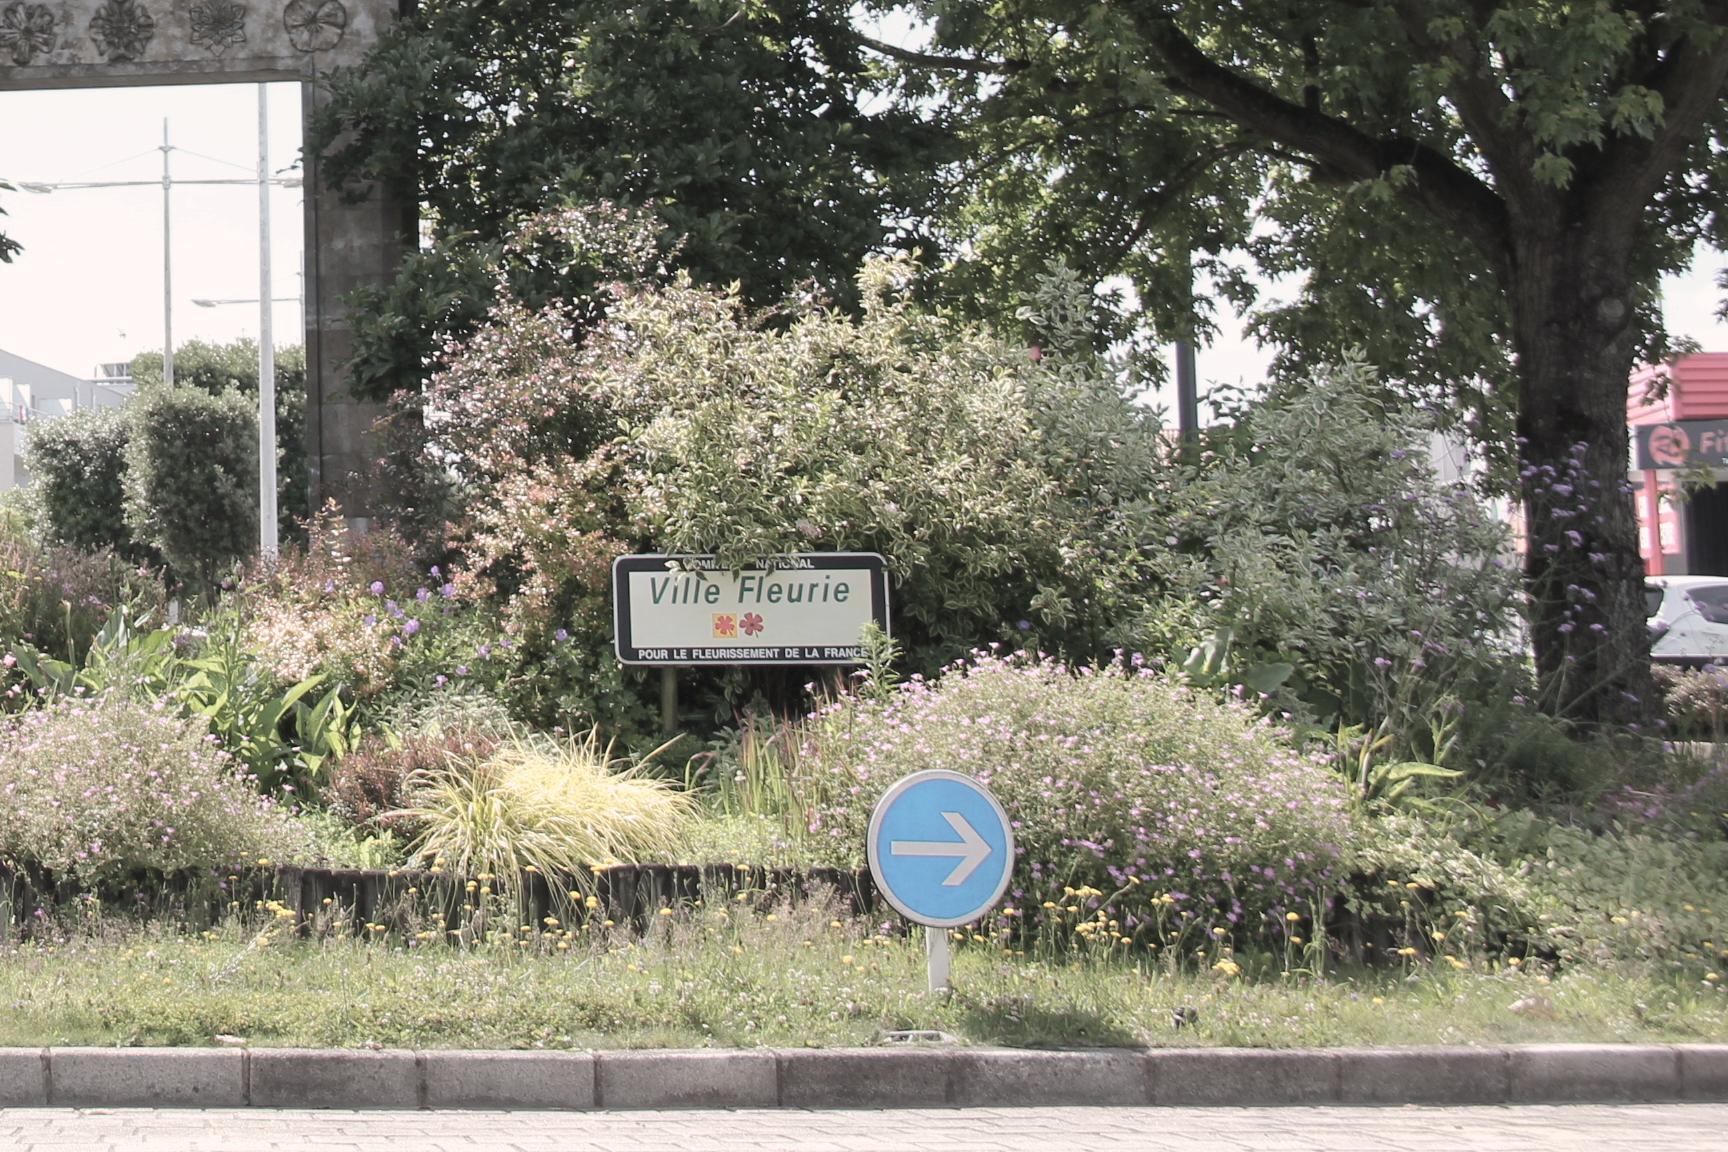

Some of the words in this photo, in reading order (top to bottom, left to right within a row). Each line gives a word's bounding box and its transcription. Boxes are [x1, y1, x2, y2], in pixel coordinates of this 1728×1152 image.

[650, 576, 721, 605] Ville
[738, 574, 850, 604] Fleurie
[638, 649, 669, 660] POUR
[673, 649, 688, 660] LE
[692, 648, 781, 659] FLEURISSEMENT
[785, 648, 801, 659] DE
[804, 647, 820, 658] LA
[824, 647, 869, 658] FRANCE
